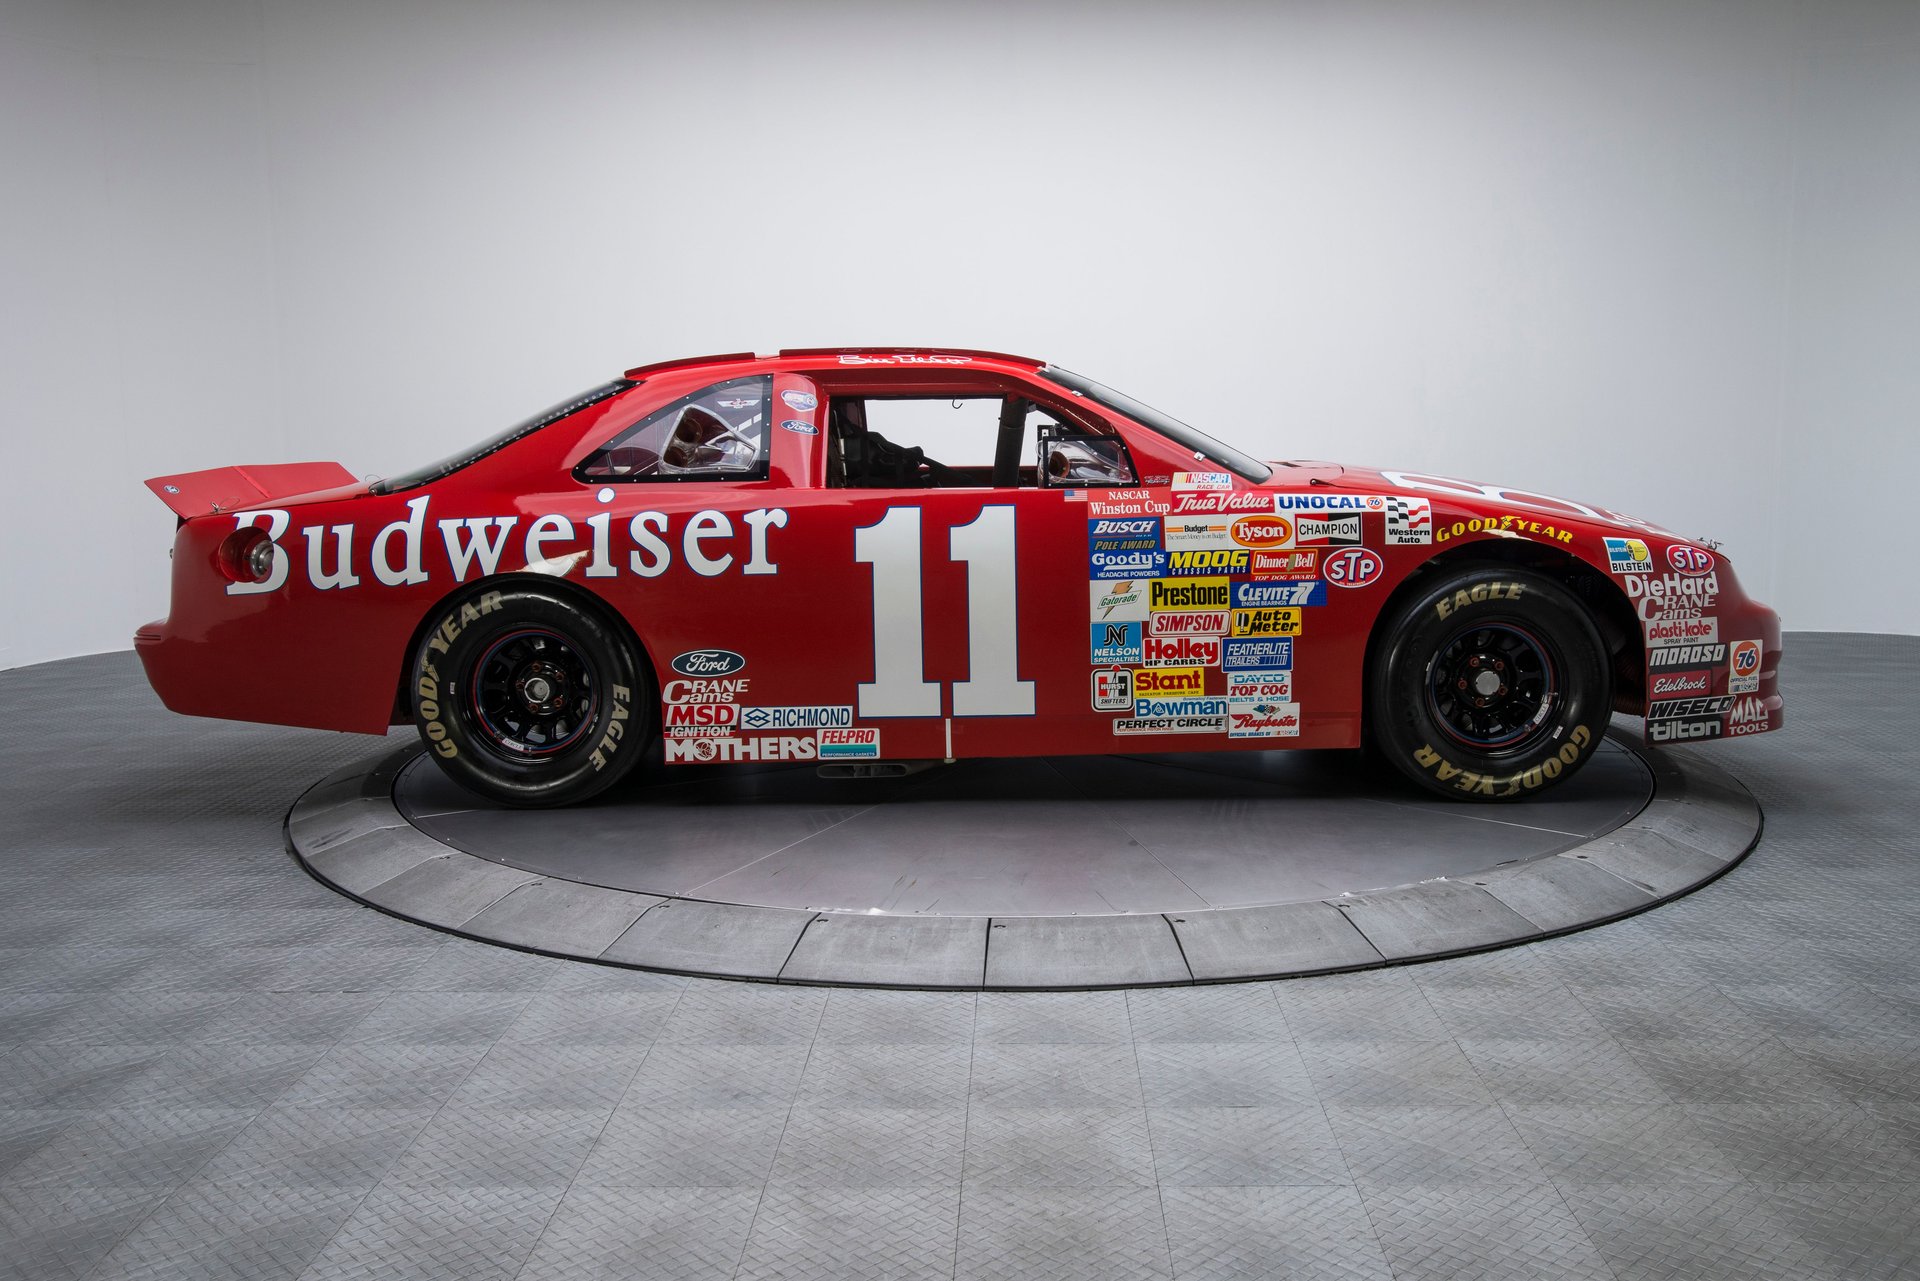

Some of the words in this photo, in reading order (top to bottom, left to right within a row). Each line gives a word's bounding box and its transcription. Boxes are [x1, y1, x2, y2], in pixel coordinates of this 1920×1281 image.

[1188, 474, 1230, 484] NASCAR
[1108, 490, 1150, 500] NASCAR
[1278, 496, 1366, 509] UNOCAL
[1369, 498, 1380, 506] 76
[1090, 501, 1142, 515] Winston
[1144, 500, 1171, 515] Cup
[1093, 520, 1156, 534] BUSCH
[1184, 524, 1209, 534] Budget
[1235, 522, 1285, 541] Tyson
[1299, 523, 1358, 536] CHAMPION
[1388, 528, 1431, 536] Western
[225, 487, 789, 596] Budweiser
[1095, 540, 1119, 551] POLE
[1120, 539, 1156, 550] AWARD
[1397, 536, 1421, 544] Auto
[1091, 551, 1165, 571] Goody's
[1168, 550, 1250, 569] MOOG
[1255, 553, 1289, 569] Dinner
[1294, 552, 1315, 568] Bell
[1330, 551, 1375, 582] STP
[1611, 561, 1652, 572] BILSTEIN
[1673, 547, 1709, 570] STP
[1171, 567, 1211, 576] CHASSIS
[1217, 566, 1246, 574] PARTS
[1237, 583, 1291, 602] CLEVITE
[1624, 571, 1719, 598] DieHard
[1100, 593, 1138, 607] Gatorade
[1151, 581, 1228, 607] Prestone
[1434, 581, 1528, 622] EAGLE
[854, 503, 1036, 719] 11
[1637, 593, 1716, 621] CRANE
[1155, 614, 1225, 633] SIMPSON
[1252, 610, 1292, 622] Auto
[1250, 621, 1299, 634] Meter
[1094, 647, 1140, 657] NELSON
[1144, 637, 1219, 665] Holley
[1227, 642, 1291, 656] FEATHERLITE
[685, 652, 730, 672] Ford
[1144, 659, 1161, 667] HP
[1163, 658, 1205, 666] CARBS
[1228, 656, 1261, 666] TRAILERS
[1735, 647, 1757, 670] 76
[1100, 682, 1126, 690] HURST
[1135, 670, 1201, 692] Stant
[1233, 673, 1285, 684] DAYCO
[1653, 675, 1707, 694] Edelbrock
[662, 679, 750, 704] CRANE
[1230, 685, 1258, 697] TOP
[1260, 684, 1289, 696] COG
[670, 704, 735, 726] MSD
[1135, 698, 1227, 717] Bowman
[1647, 695, 1736, 720] WISECO
[772, 708, 850, 727] RICHMOND
[1116, 719, 1175, 729] PERFECT
[1176, 718, 1224, 727] CIRCLE
[589, 683, 631, 772] EAGLE
[670, 726, 731, 738] IGNITION
[1649, 720, 1721, 741] tilton
[1729, 721, 1769, 735] TOOLS
[665, 737, 817, 762] MOTHERS
